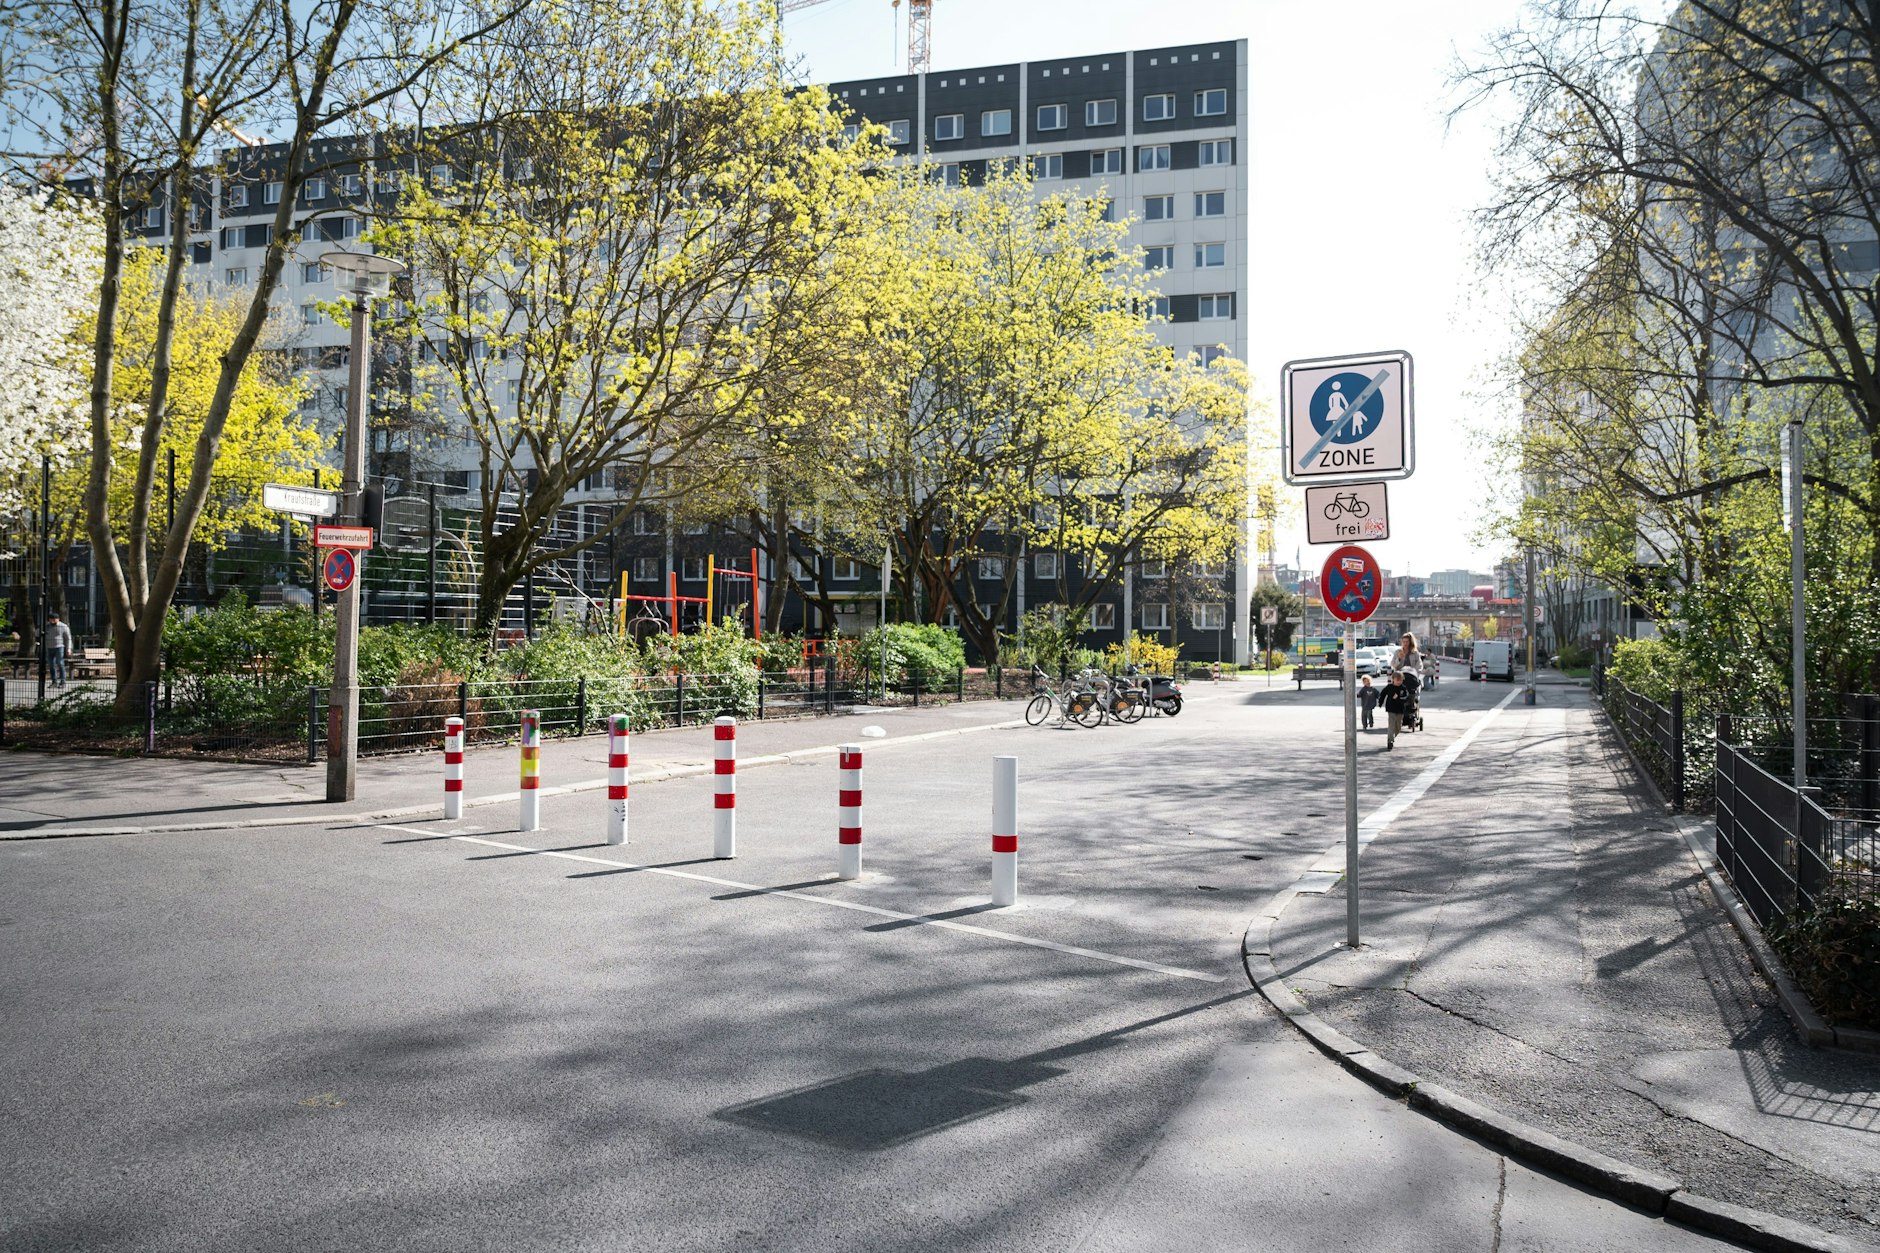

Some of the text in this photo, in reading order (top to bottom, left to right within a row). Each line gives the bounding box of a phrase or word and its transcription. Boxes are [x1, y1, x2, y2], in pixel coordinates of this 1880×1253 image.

[1319, 448, 1375, 467] ZONE
[284, 493, 321, 507] Krautstraße
[1336, 522, 1360, 535] frei
[319, 533, 368, 542] Feuerwehrzufahrt
